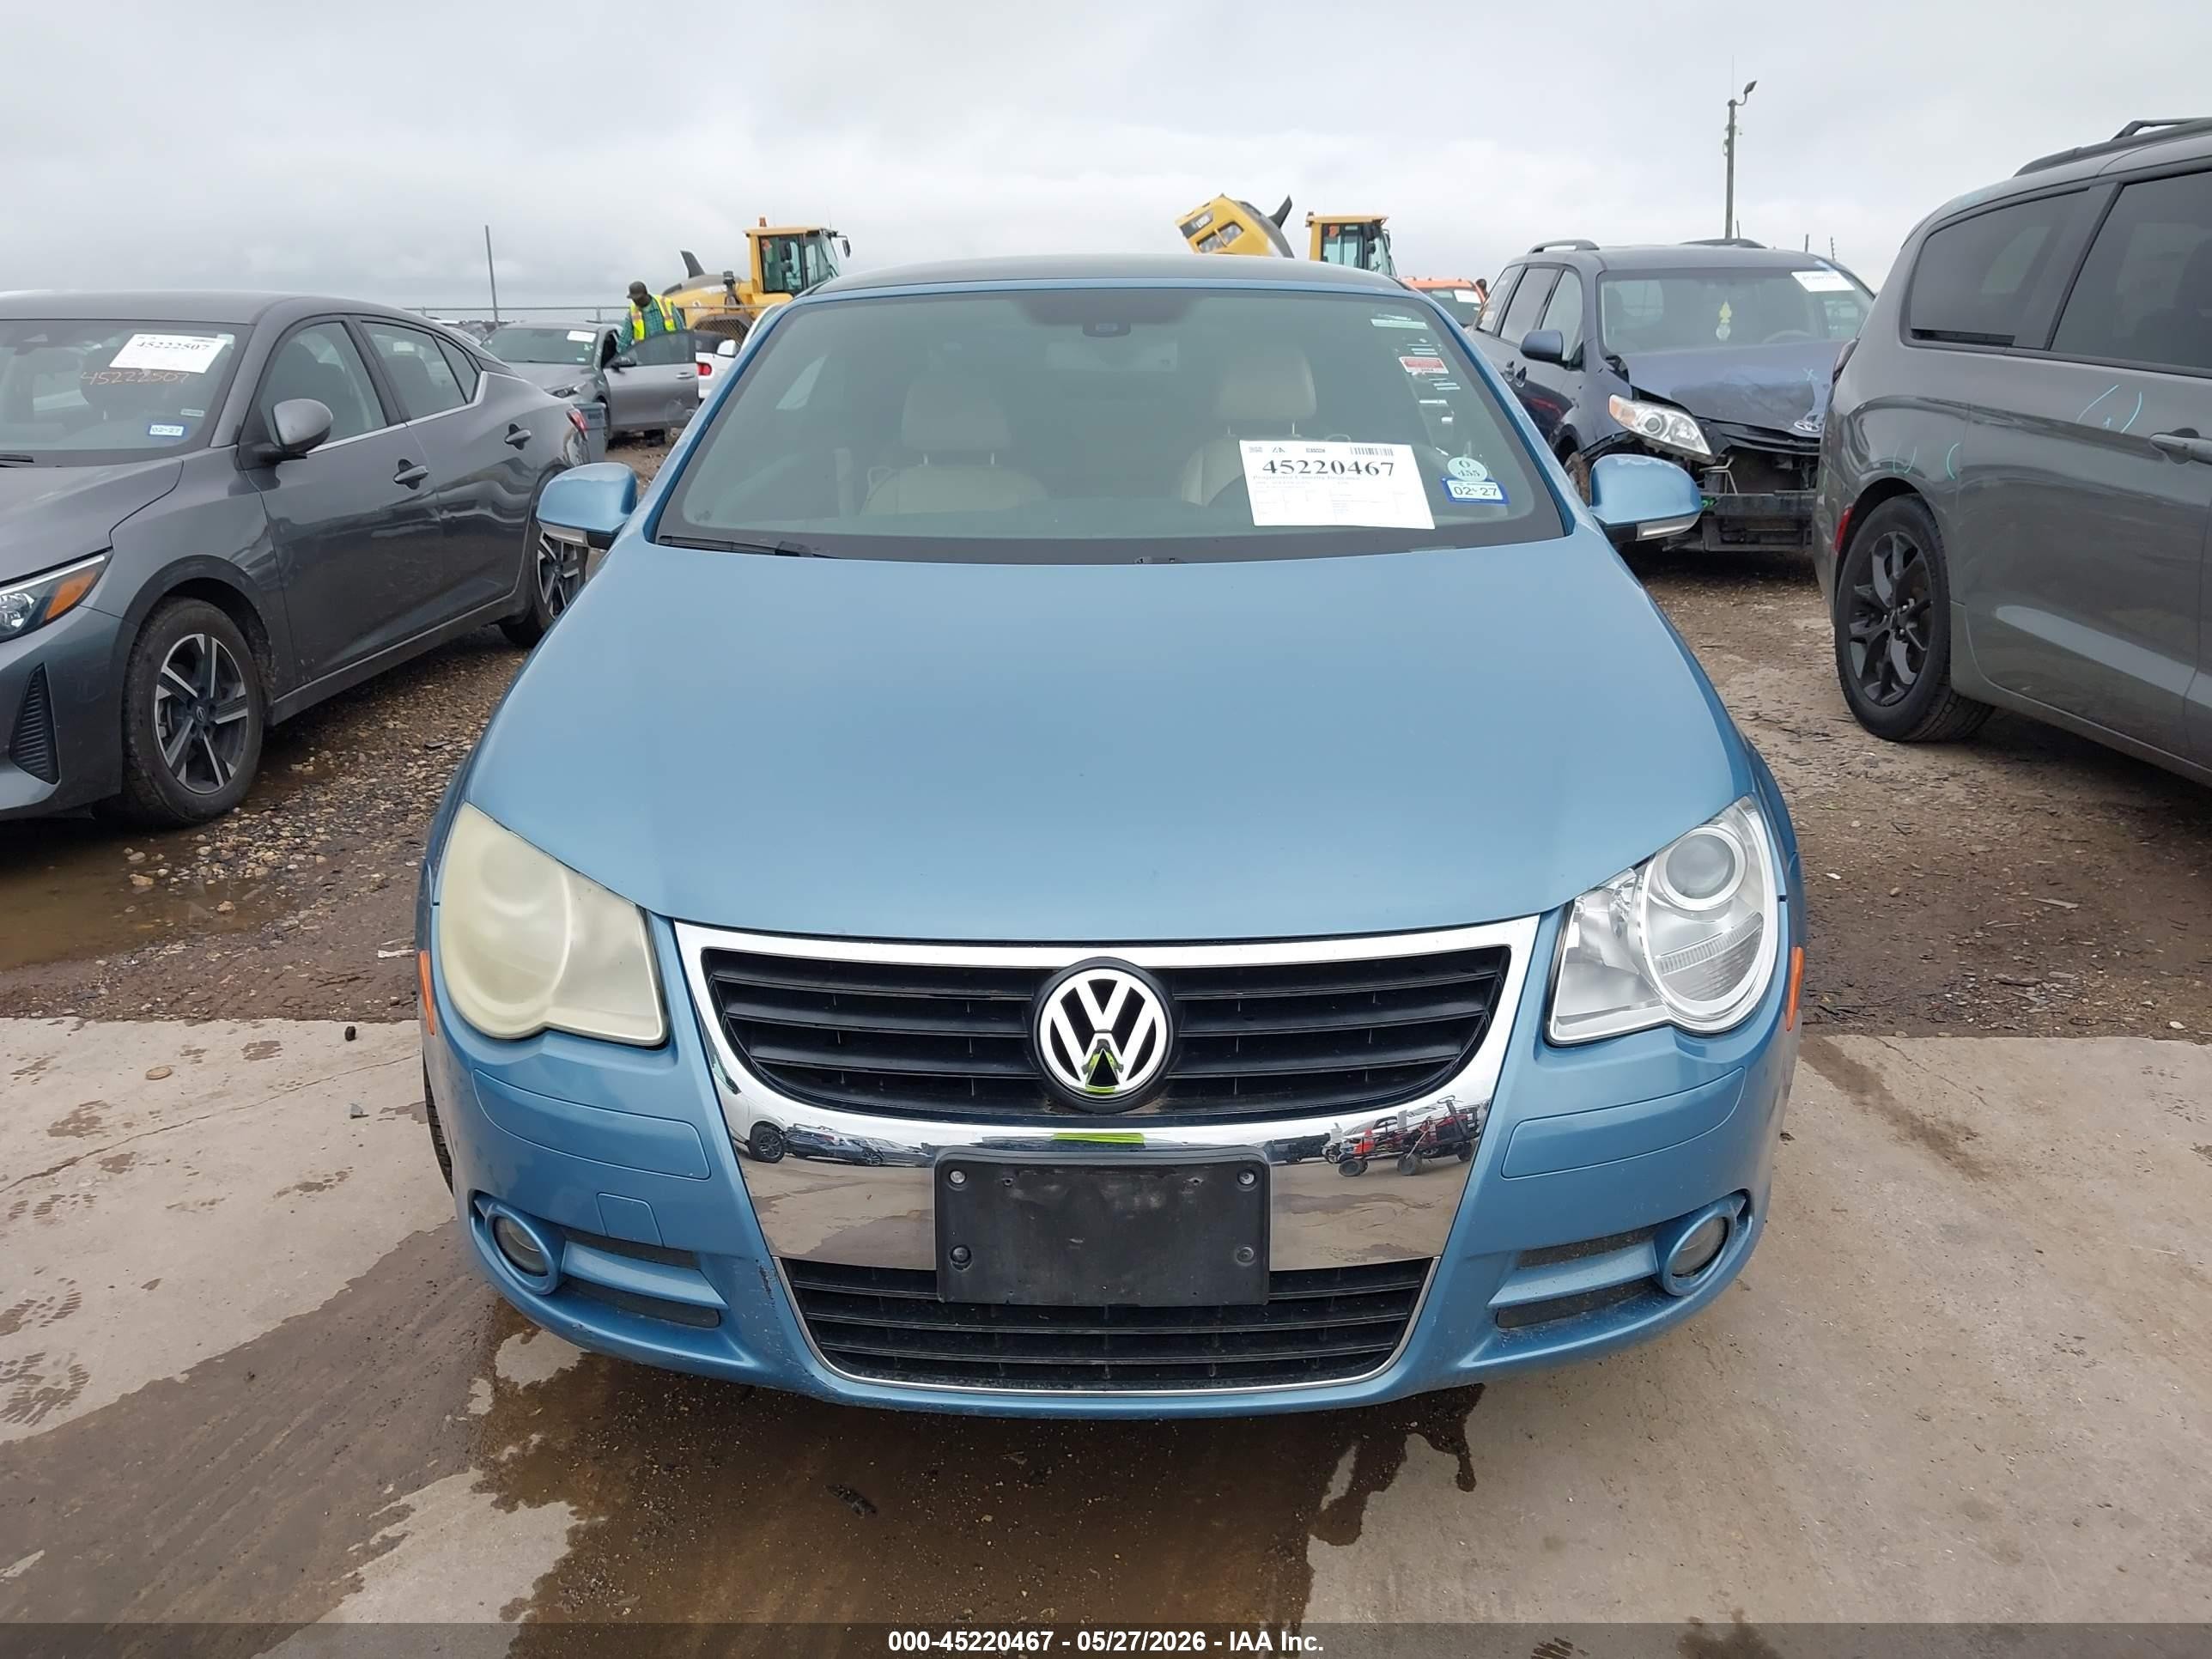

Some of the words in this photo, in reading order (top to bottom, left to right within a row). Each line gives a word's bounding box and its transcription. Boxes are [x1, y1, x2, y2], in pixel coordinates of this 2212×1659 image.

[80, 370, 191, 386] 45222507
[1261, 459, 1395, 477] 45220467
[1041, 969, 1167, 1096] VW
